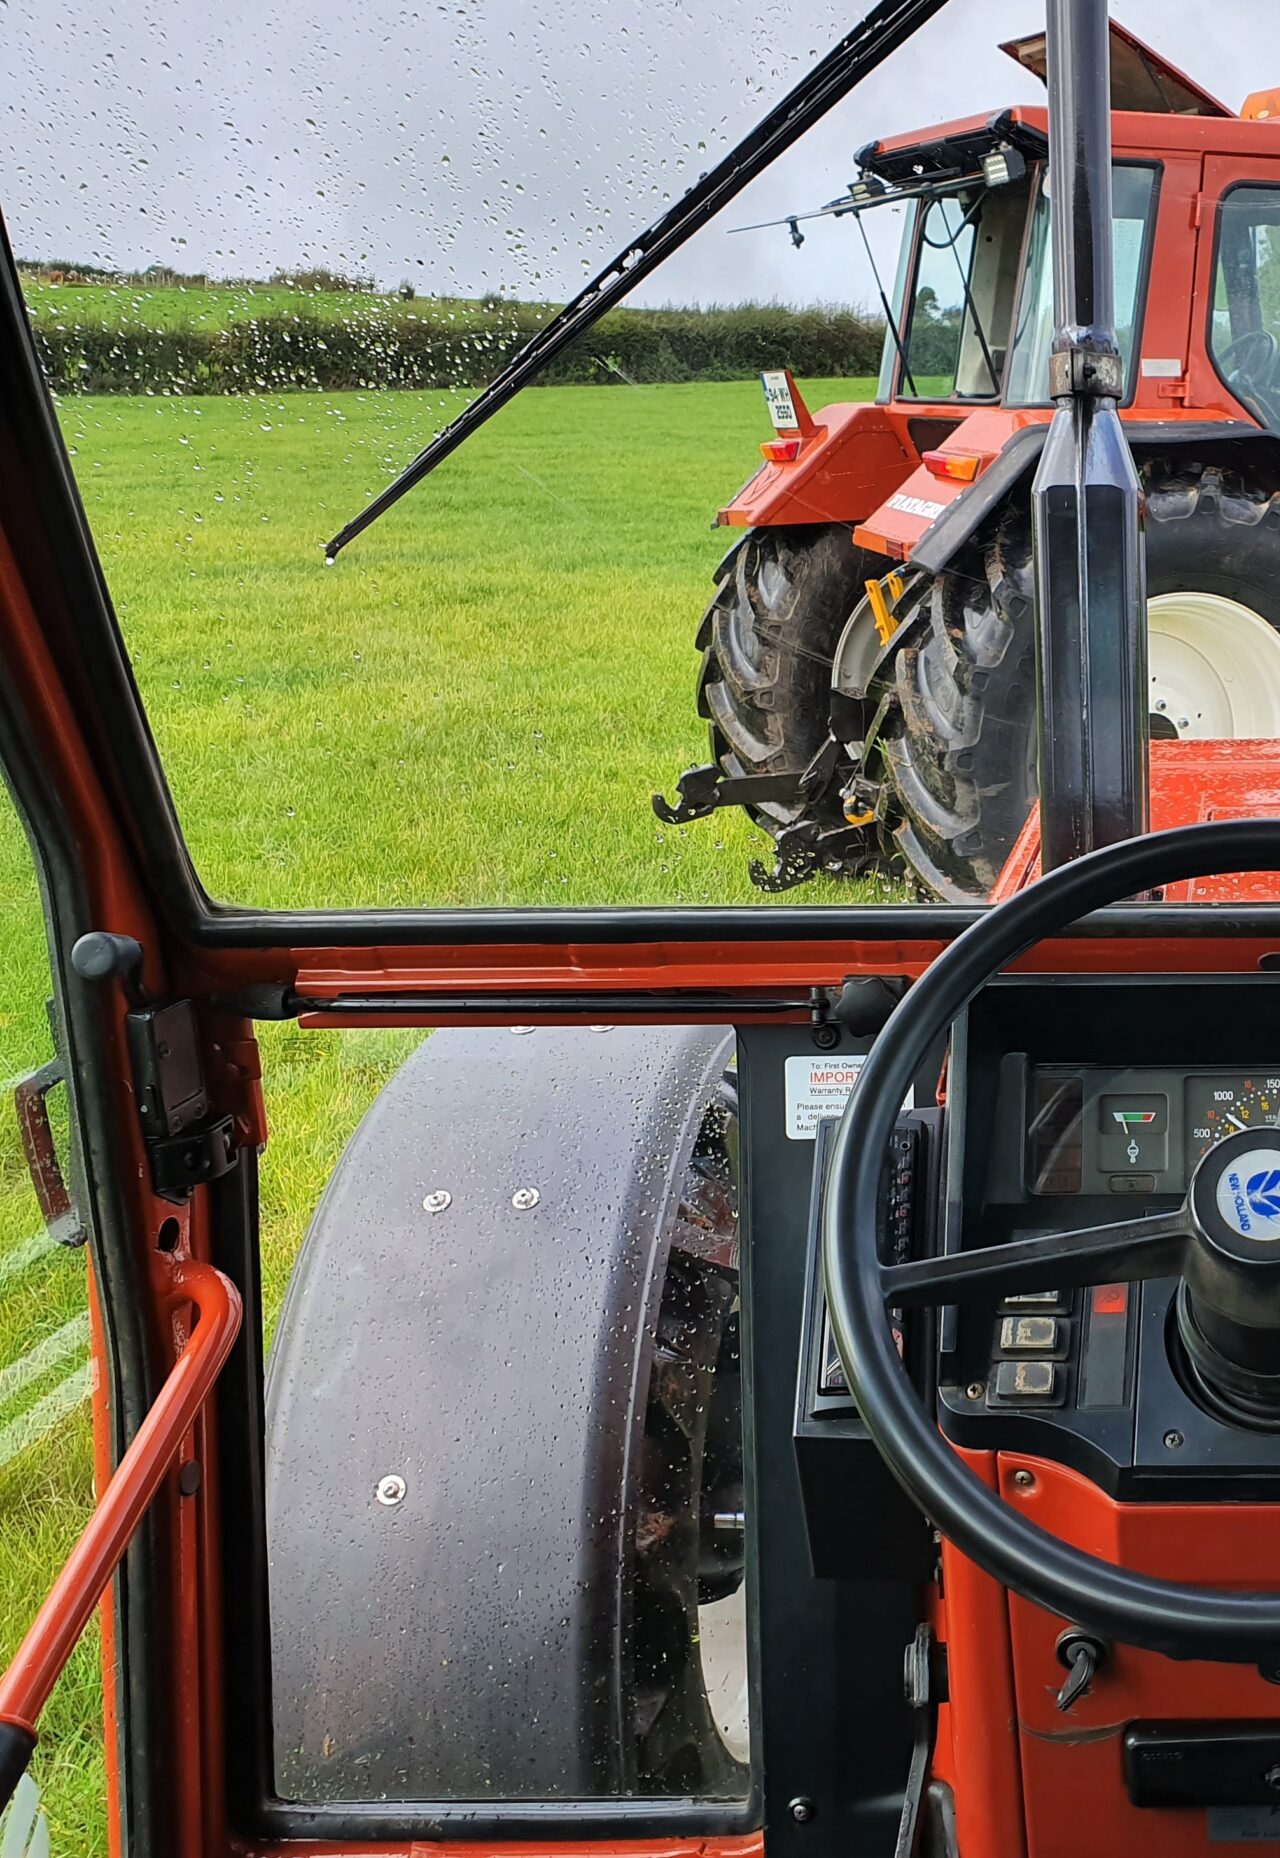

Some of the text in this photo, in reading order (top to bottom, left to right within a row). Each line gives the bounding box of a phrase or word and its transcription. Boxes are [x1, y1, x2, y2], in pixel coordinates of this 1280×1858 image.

[809, 1087, 843, 1095] Warranty
[1213, 1090, 1234, 1101] 1000
[1241, 1110, 1250, 1119] 12
[1193, 1128, 1211, 1138] 500
[1228, 1172, 1251, 1231] NEW HOLLAND
